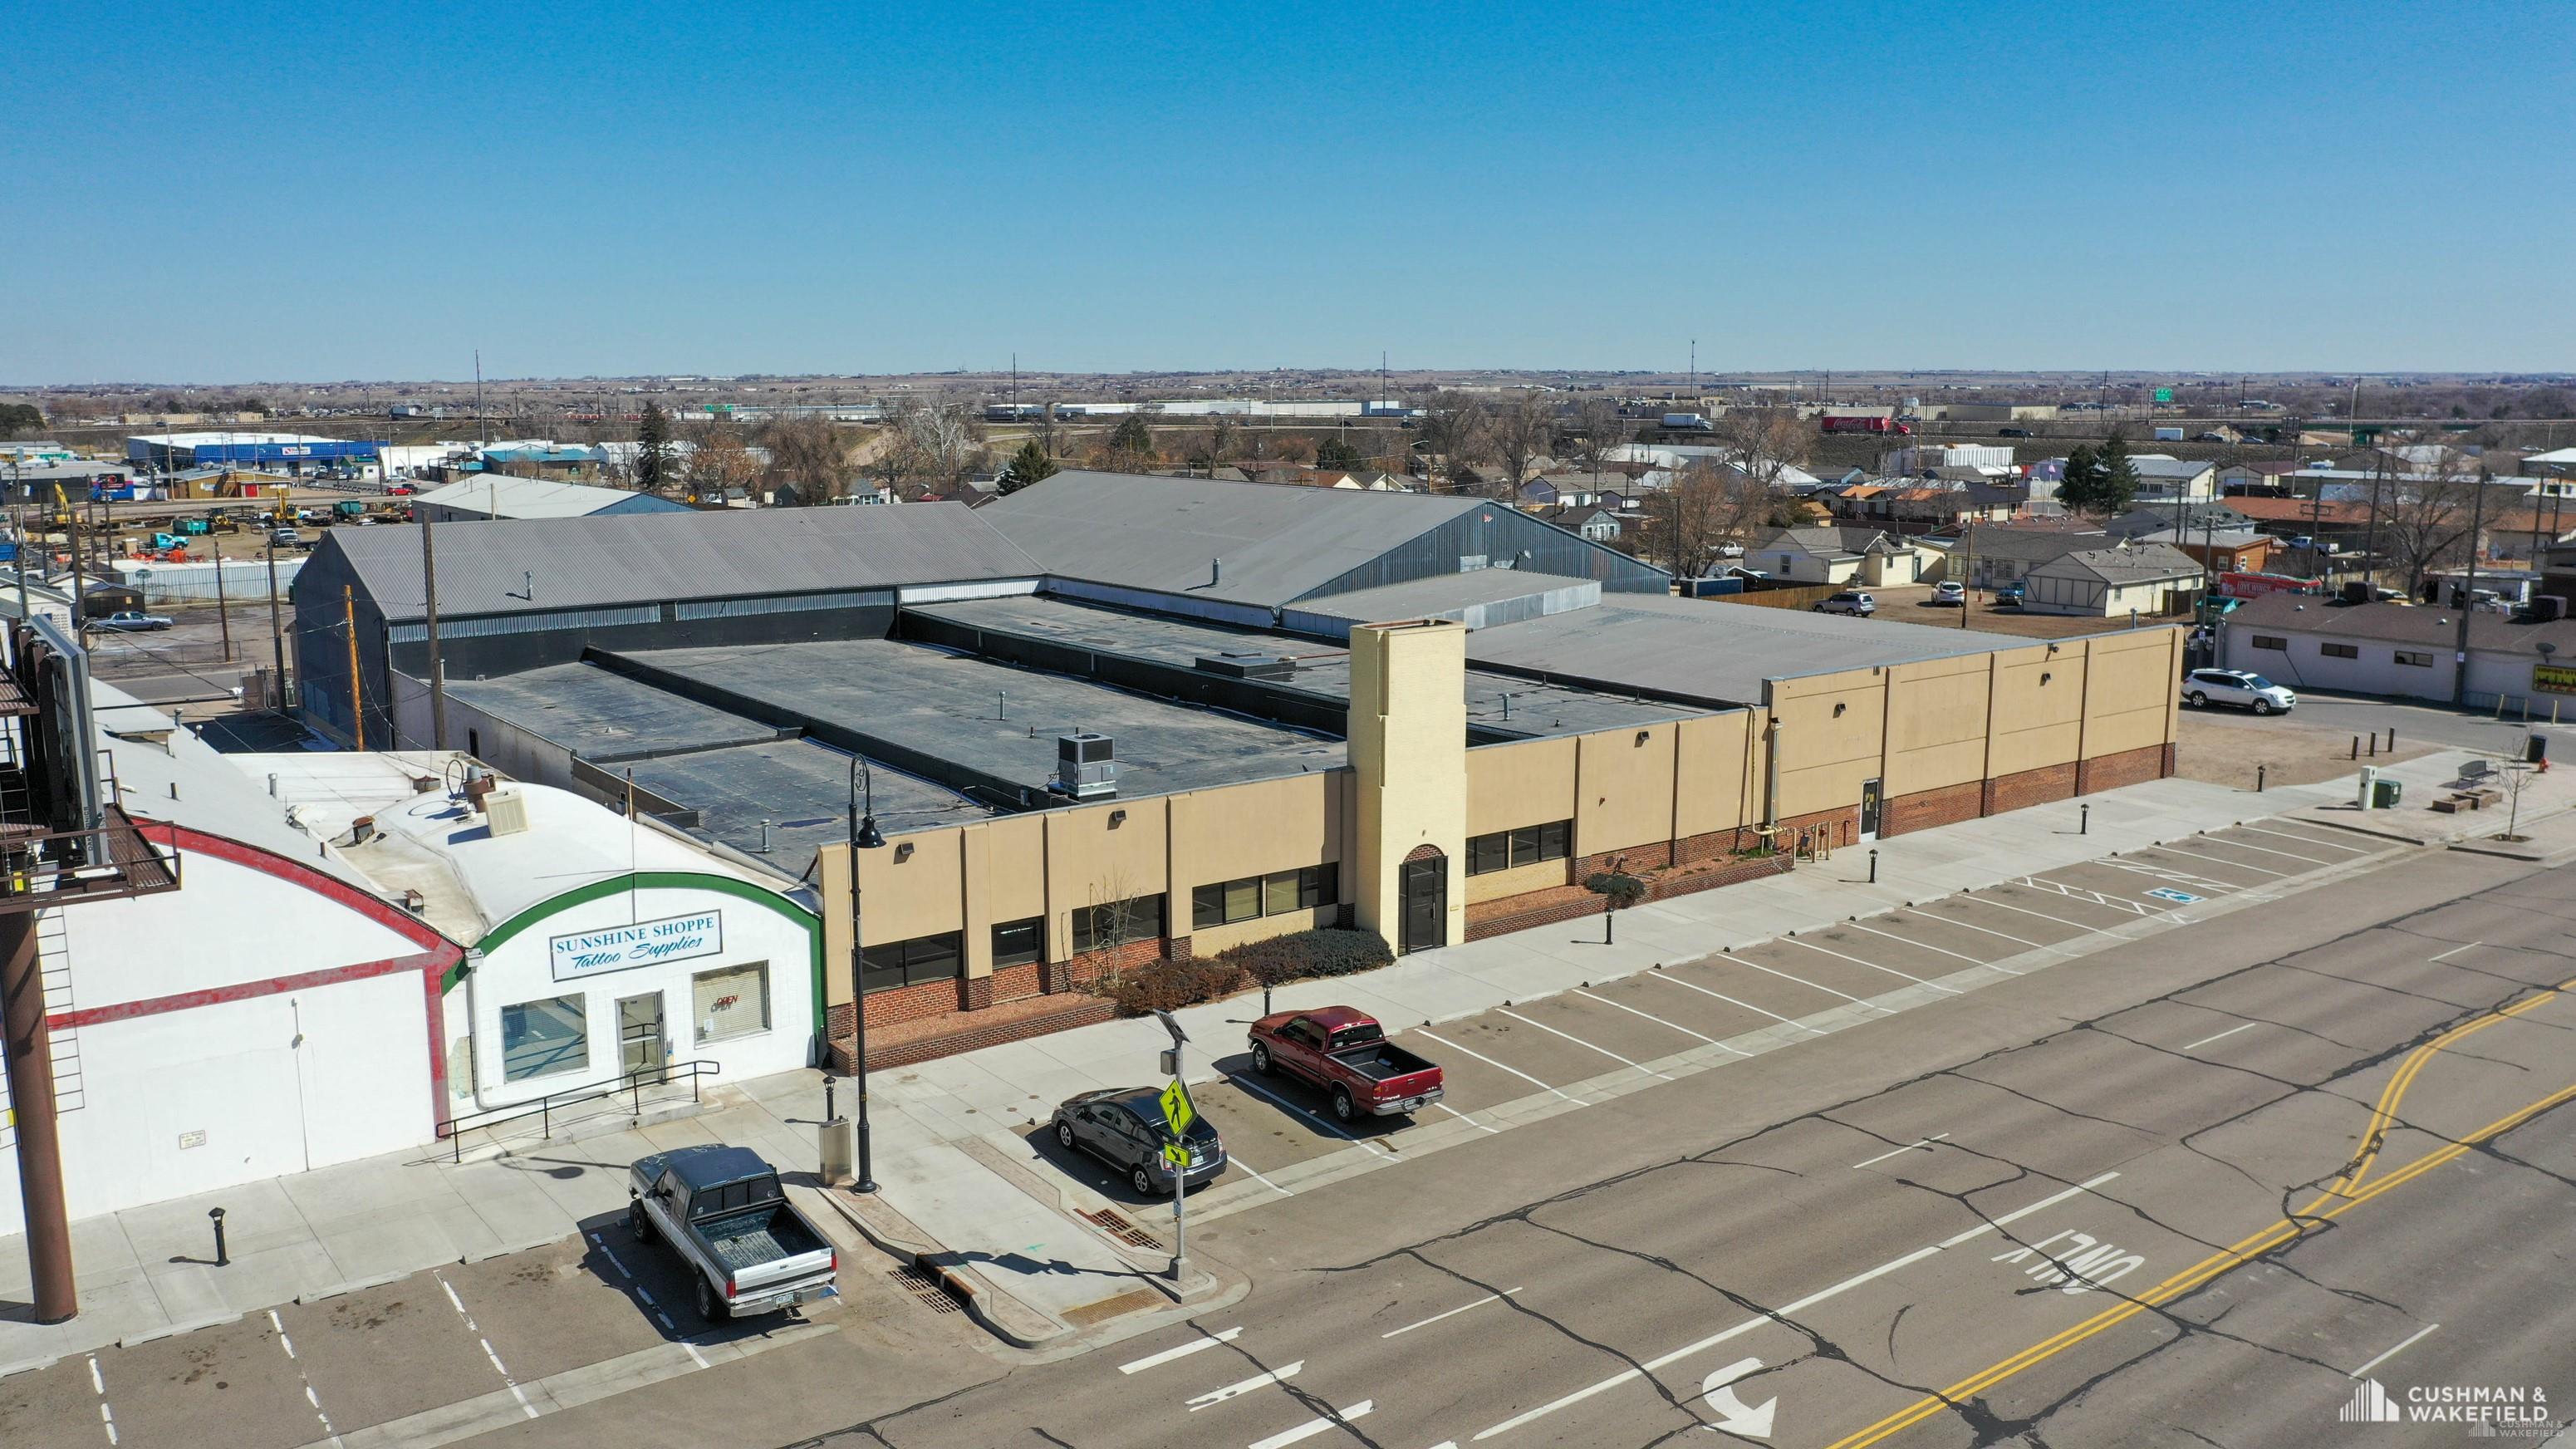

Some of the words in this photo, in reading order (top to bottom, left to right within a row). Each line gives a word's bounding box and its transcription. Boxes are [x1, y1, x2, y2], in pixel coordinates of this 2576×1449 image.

[557, 928, 647, 954] SUNSHINE
[653, 916, 714, 936] SHOPPE
[571, 953, 621, 970] Tattoo
[629, 936, 703, 959] Supplies
[716, 995, 738, 1005] OPEN
[1990, 1229, 2145, 1294] ONLY
